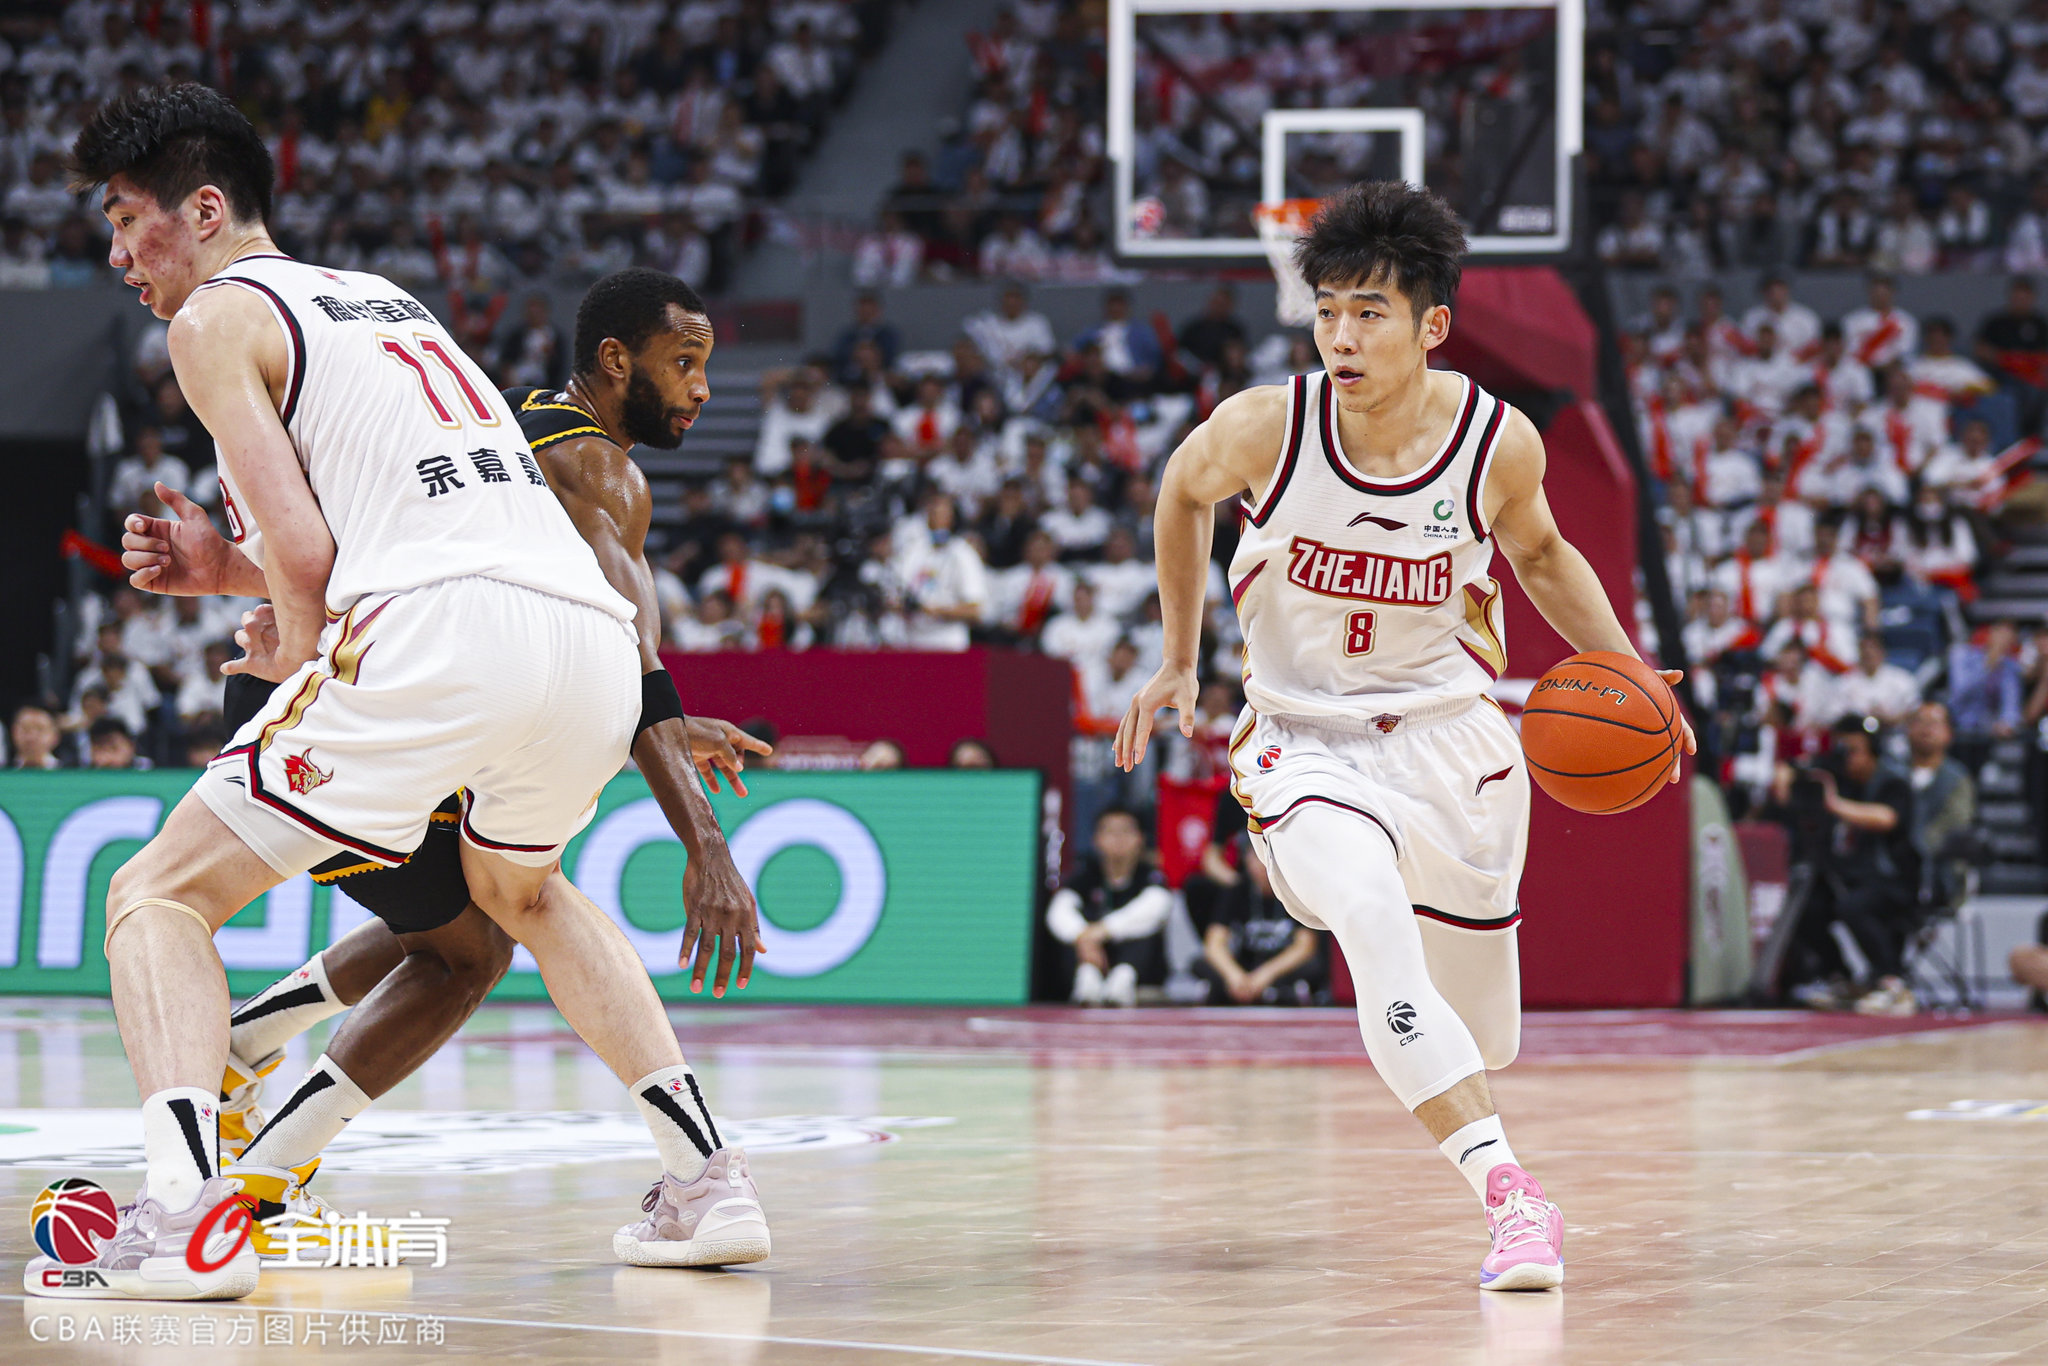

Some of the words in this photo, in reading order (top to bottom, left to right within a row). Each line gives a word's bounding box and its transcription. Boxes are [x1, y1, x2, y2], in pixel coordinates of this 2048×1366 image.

[375, 332, 501, 430] 11
[1424, 525, 1459, 534] 中国人寿
[1291, 542, 1448, 602] ZHEJIANG
[1344, 609, 1377, 657] 8
[1537, 678, 1628, 705] LI-NING
[1399, 1032, 1425, 1047] CBA
